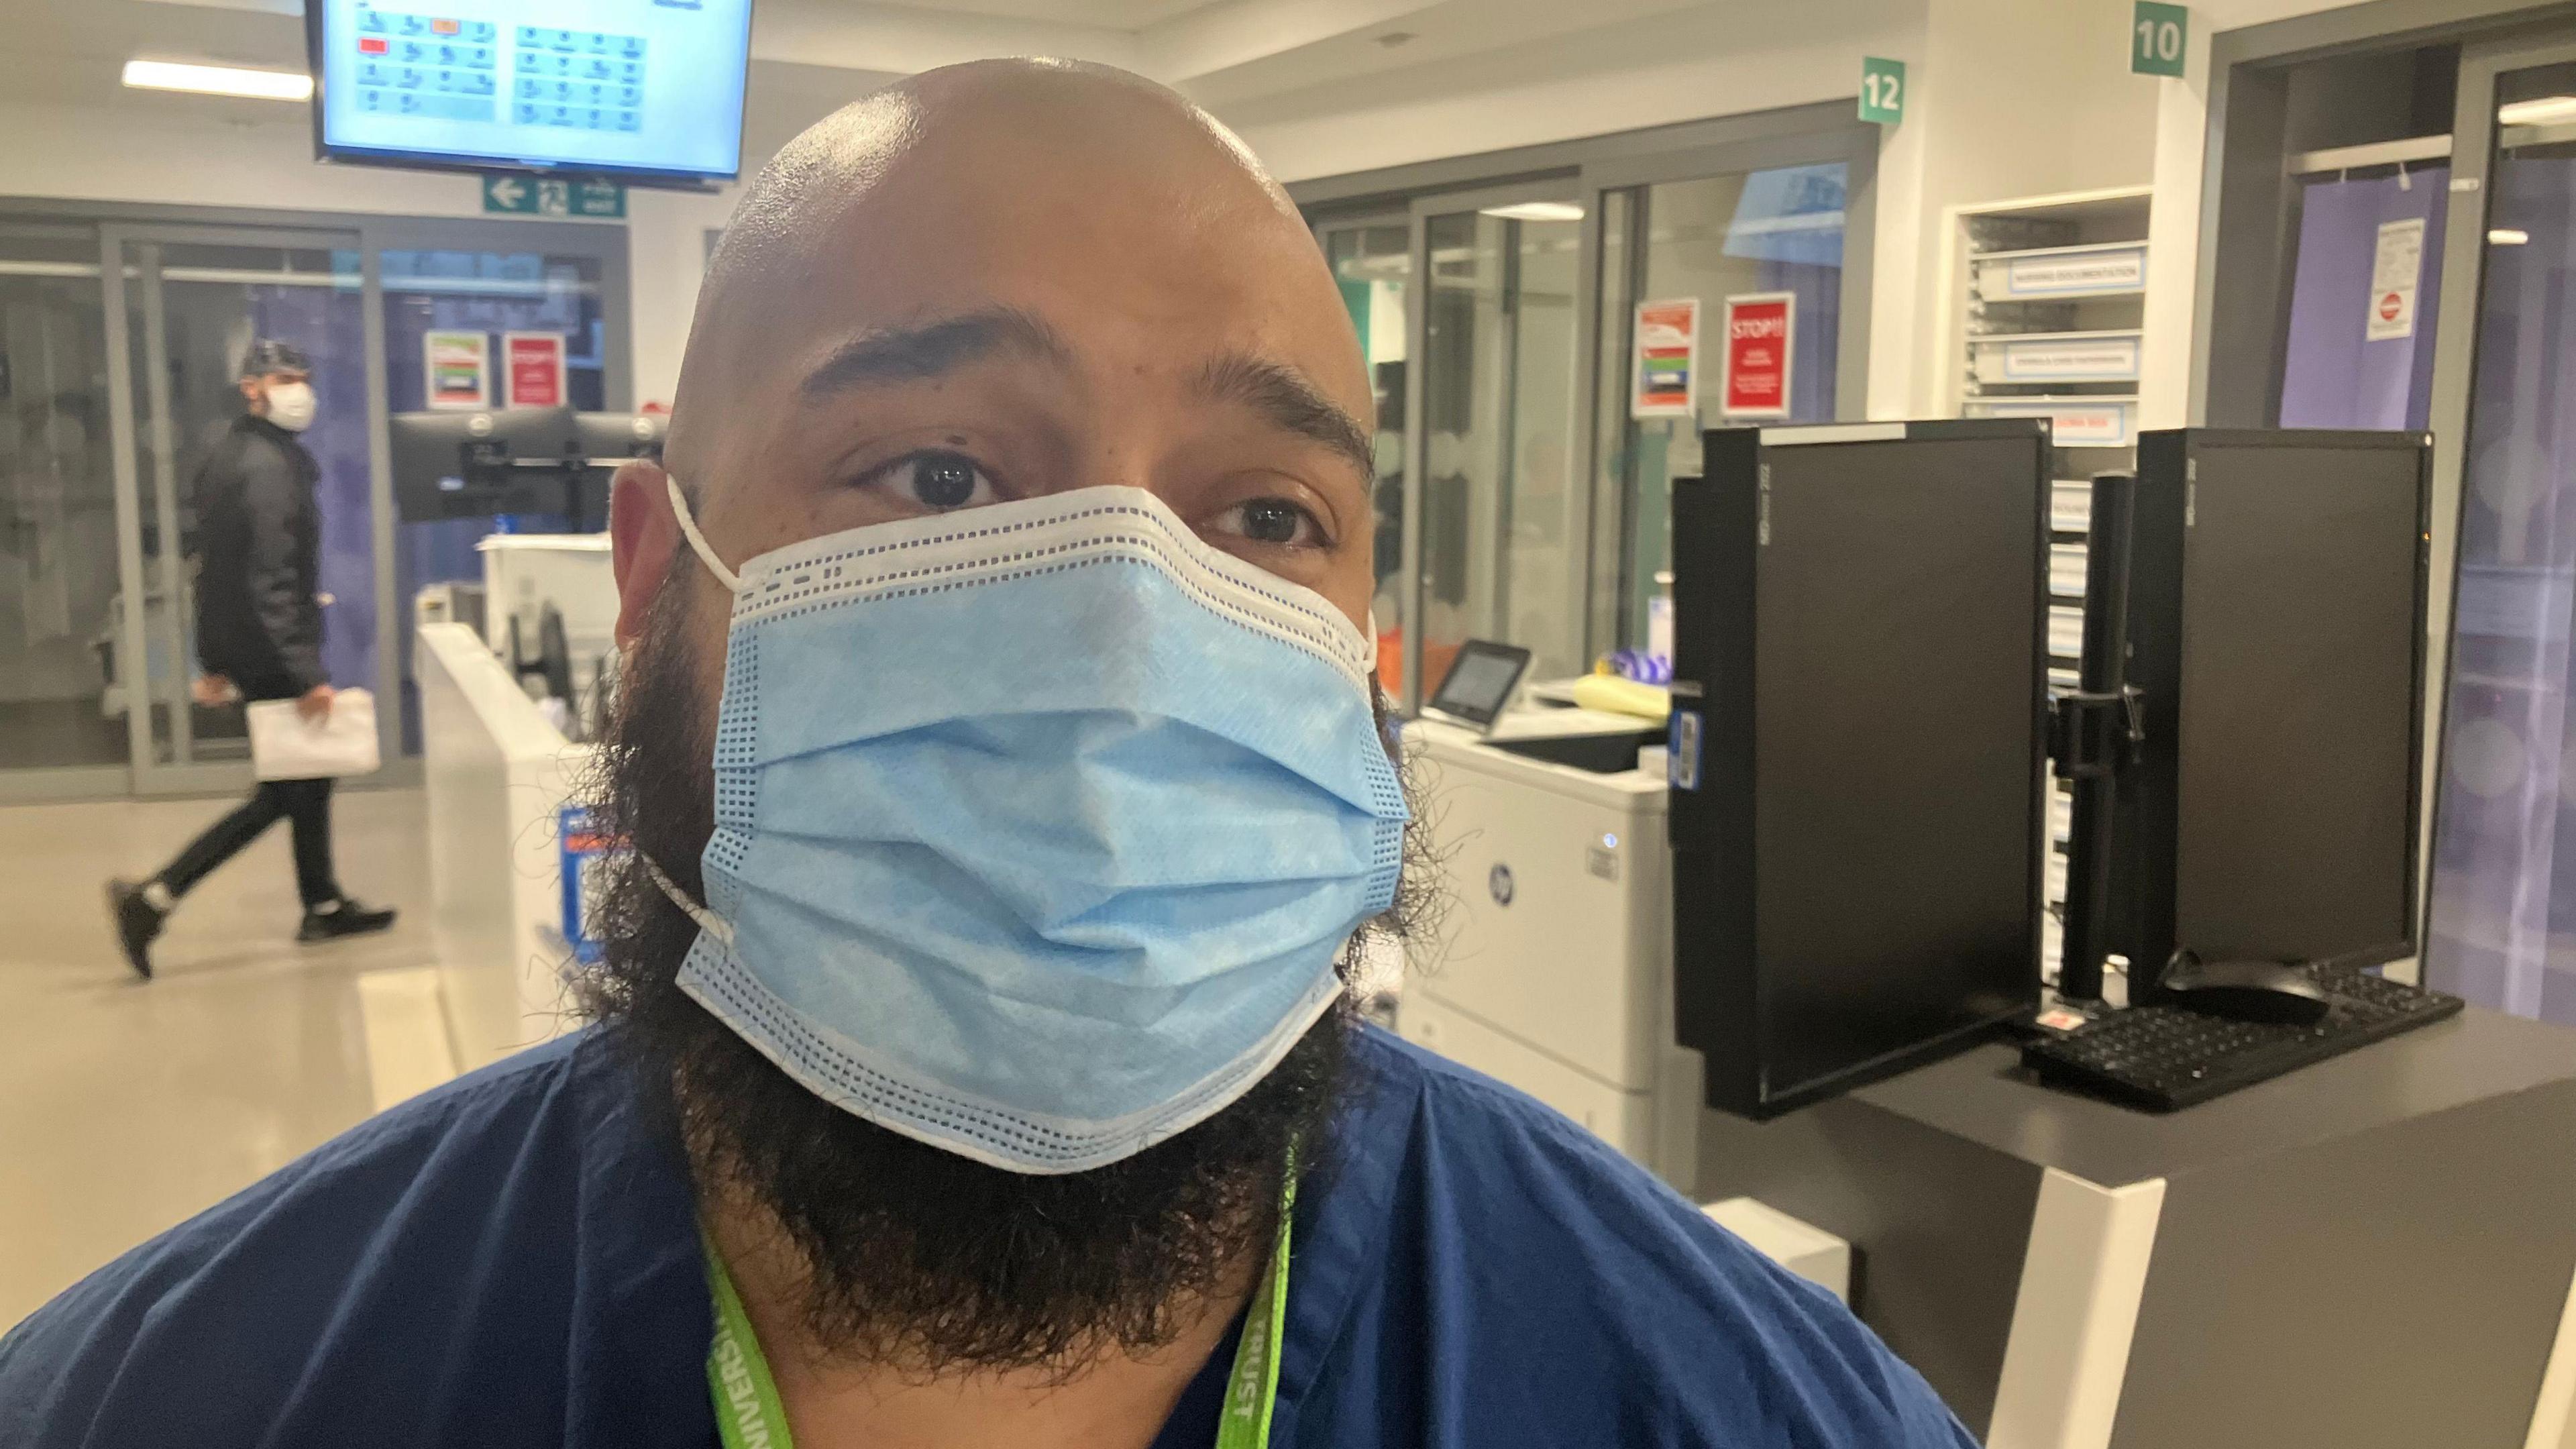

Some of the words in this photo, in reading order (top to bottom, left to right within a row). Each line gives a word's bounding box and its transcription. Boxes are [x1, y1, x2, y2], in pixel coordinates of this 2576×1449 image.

[2137, 19, 2180, 61] 10
[1864, 72, 1900, 111] 12
[1234, 1319, 1267, 1421] TRUST
